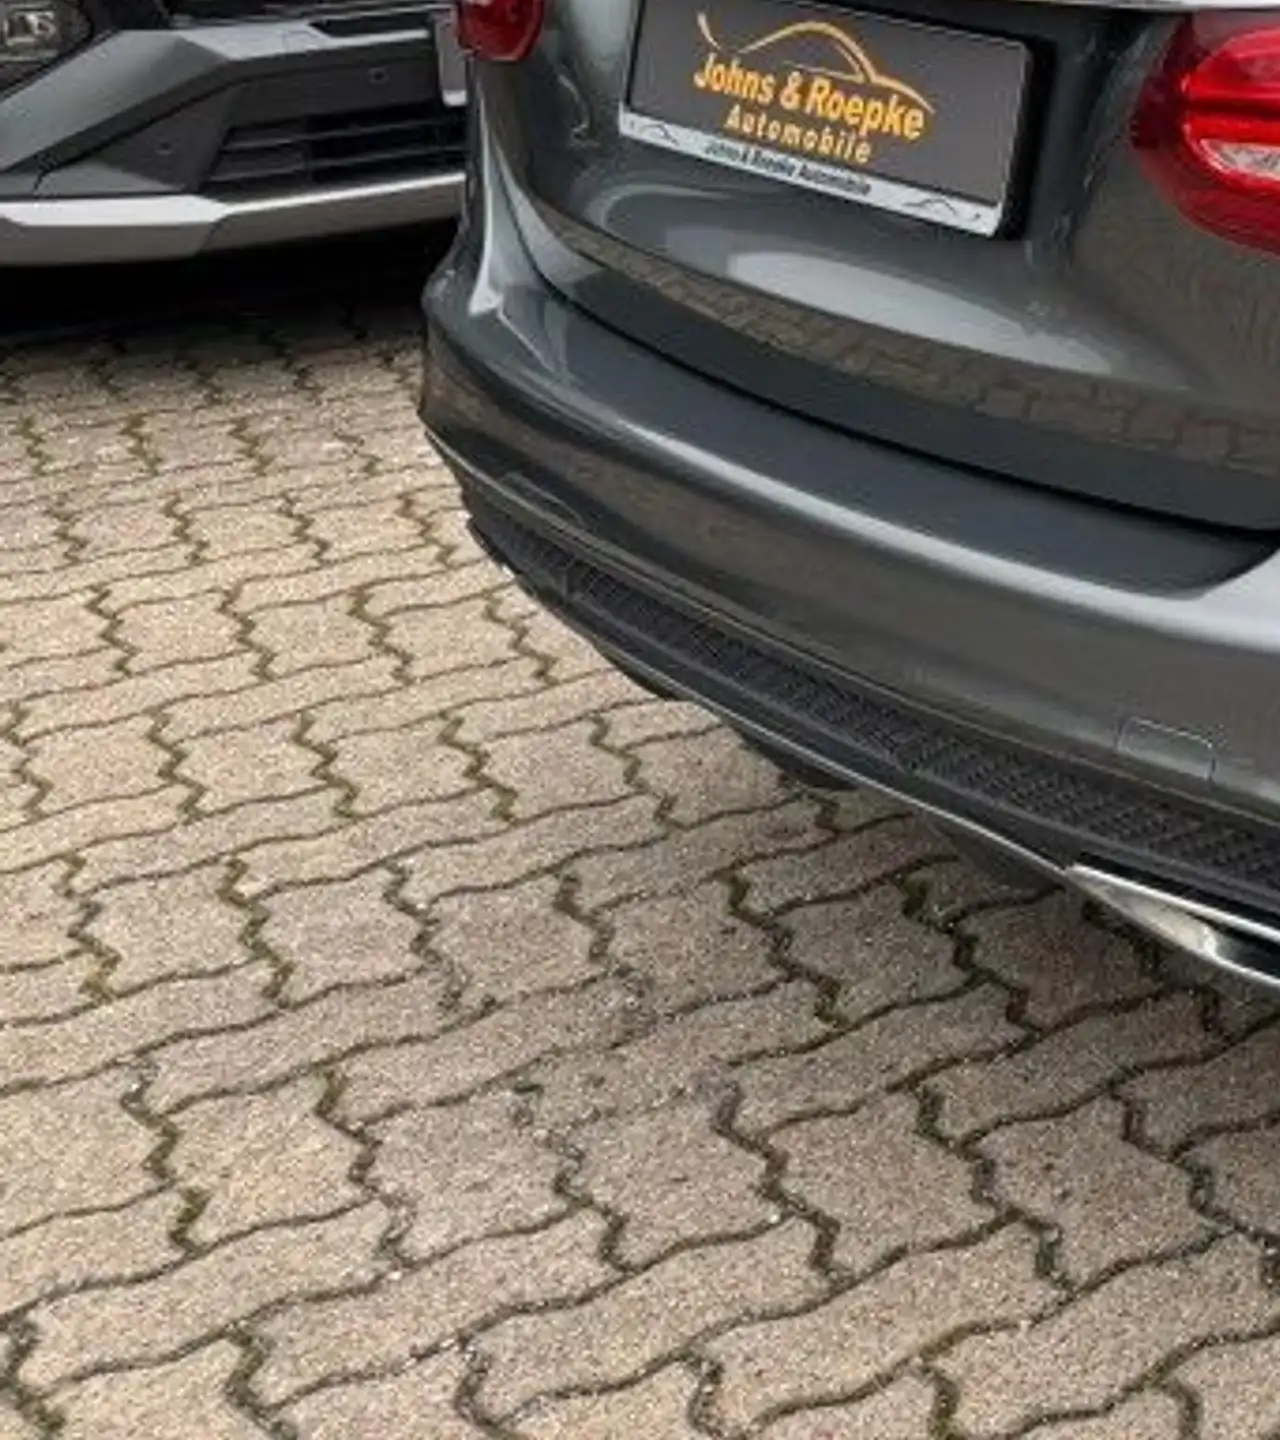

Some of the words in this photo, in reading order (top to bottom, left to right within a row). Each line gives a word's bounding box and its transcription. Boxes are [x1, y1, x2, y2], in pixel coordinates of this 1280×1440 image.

[693, 52, 776, 105] Johns
[779, 70, 803, 110] &
[804, 76, 925, 141] Roepke
[723, 104, 873, 164] Automobile
